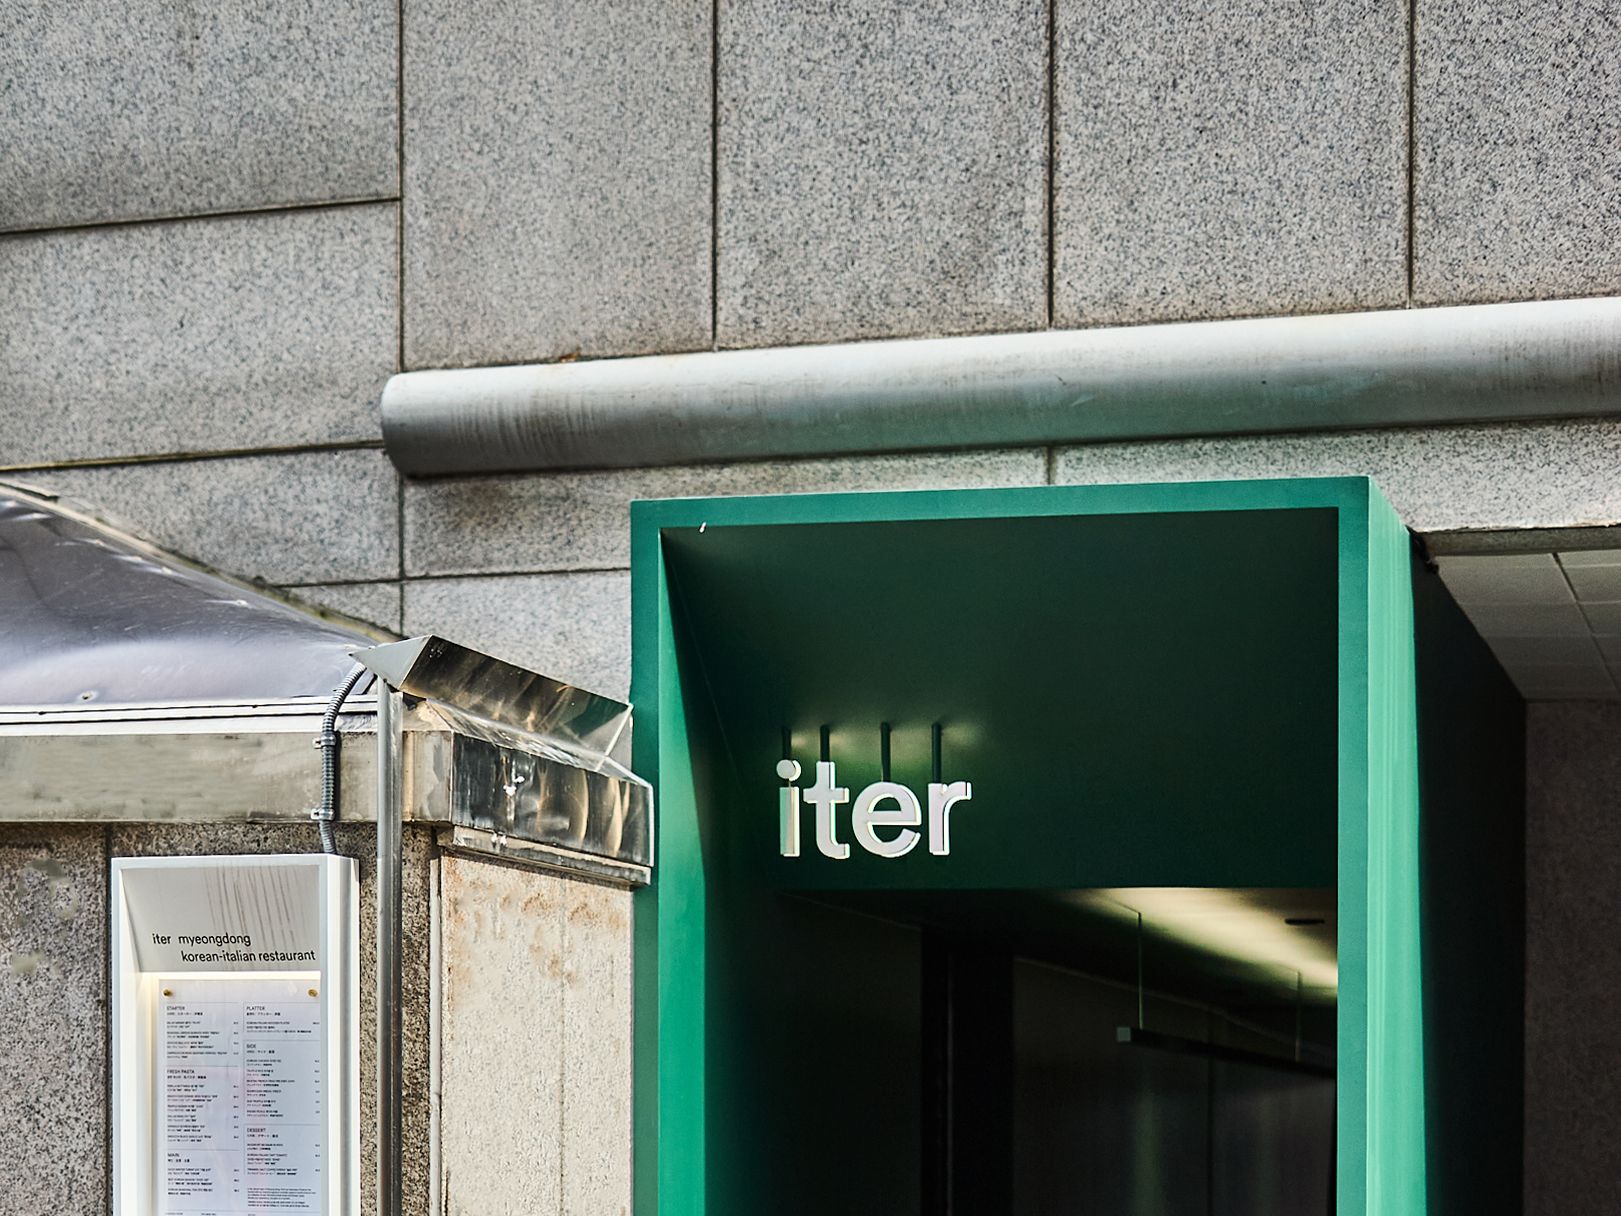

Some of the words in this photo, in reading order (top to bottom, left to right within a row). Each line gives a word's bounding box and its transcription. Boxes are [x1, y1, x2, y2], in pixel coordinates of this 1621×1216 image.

[776, 759, 972, 859] iter
[152, 933, 172, 944] iter
[178, 932, 251, 947] myeongdong
[181, 949, 257, 962] korean-italian
[258, 949, 316, 961] restaurant
